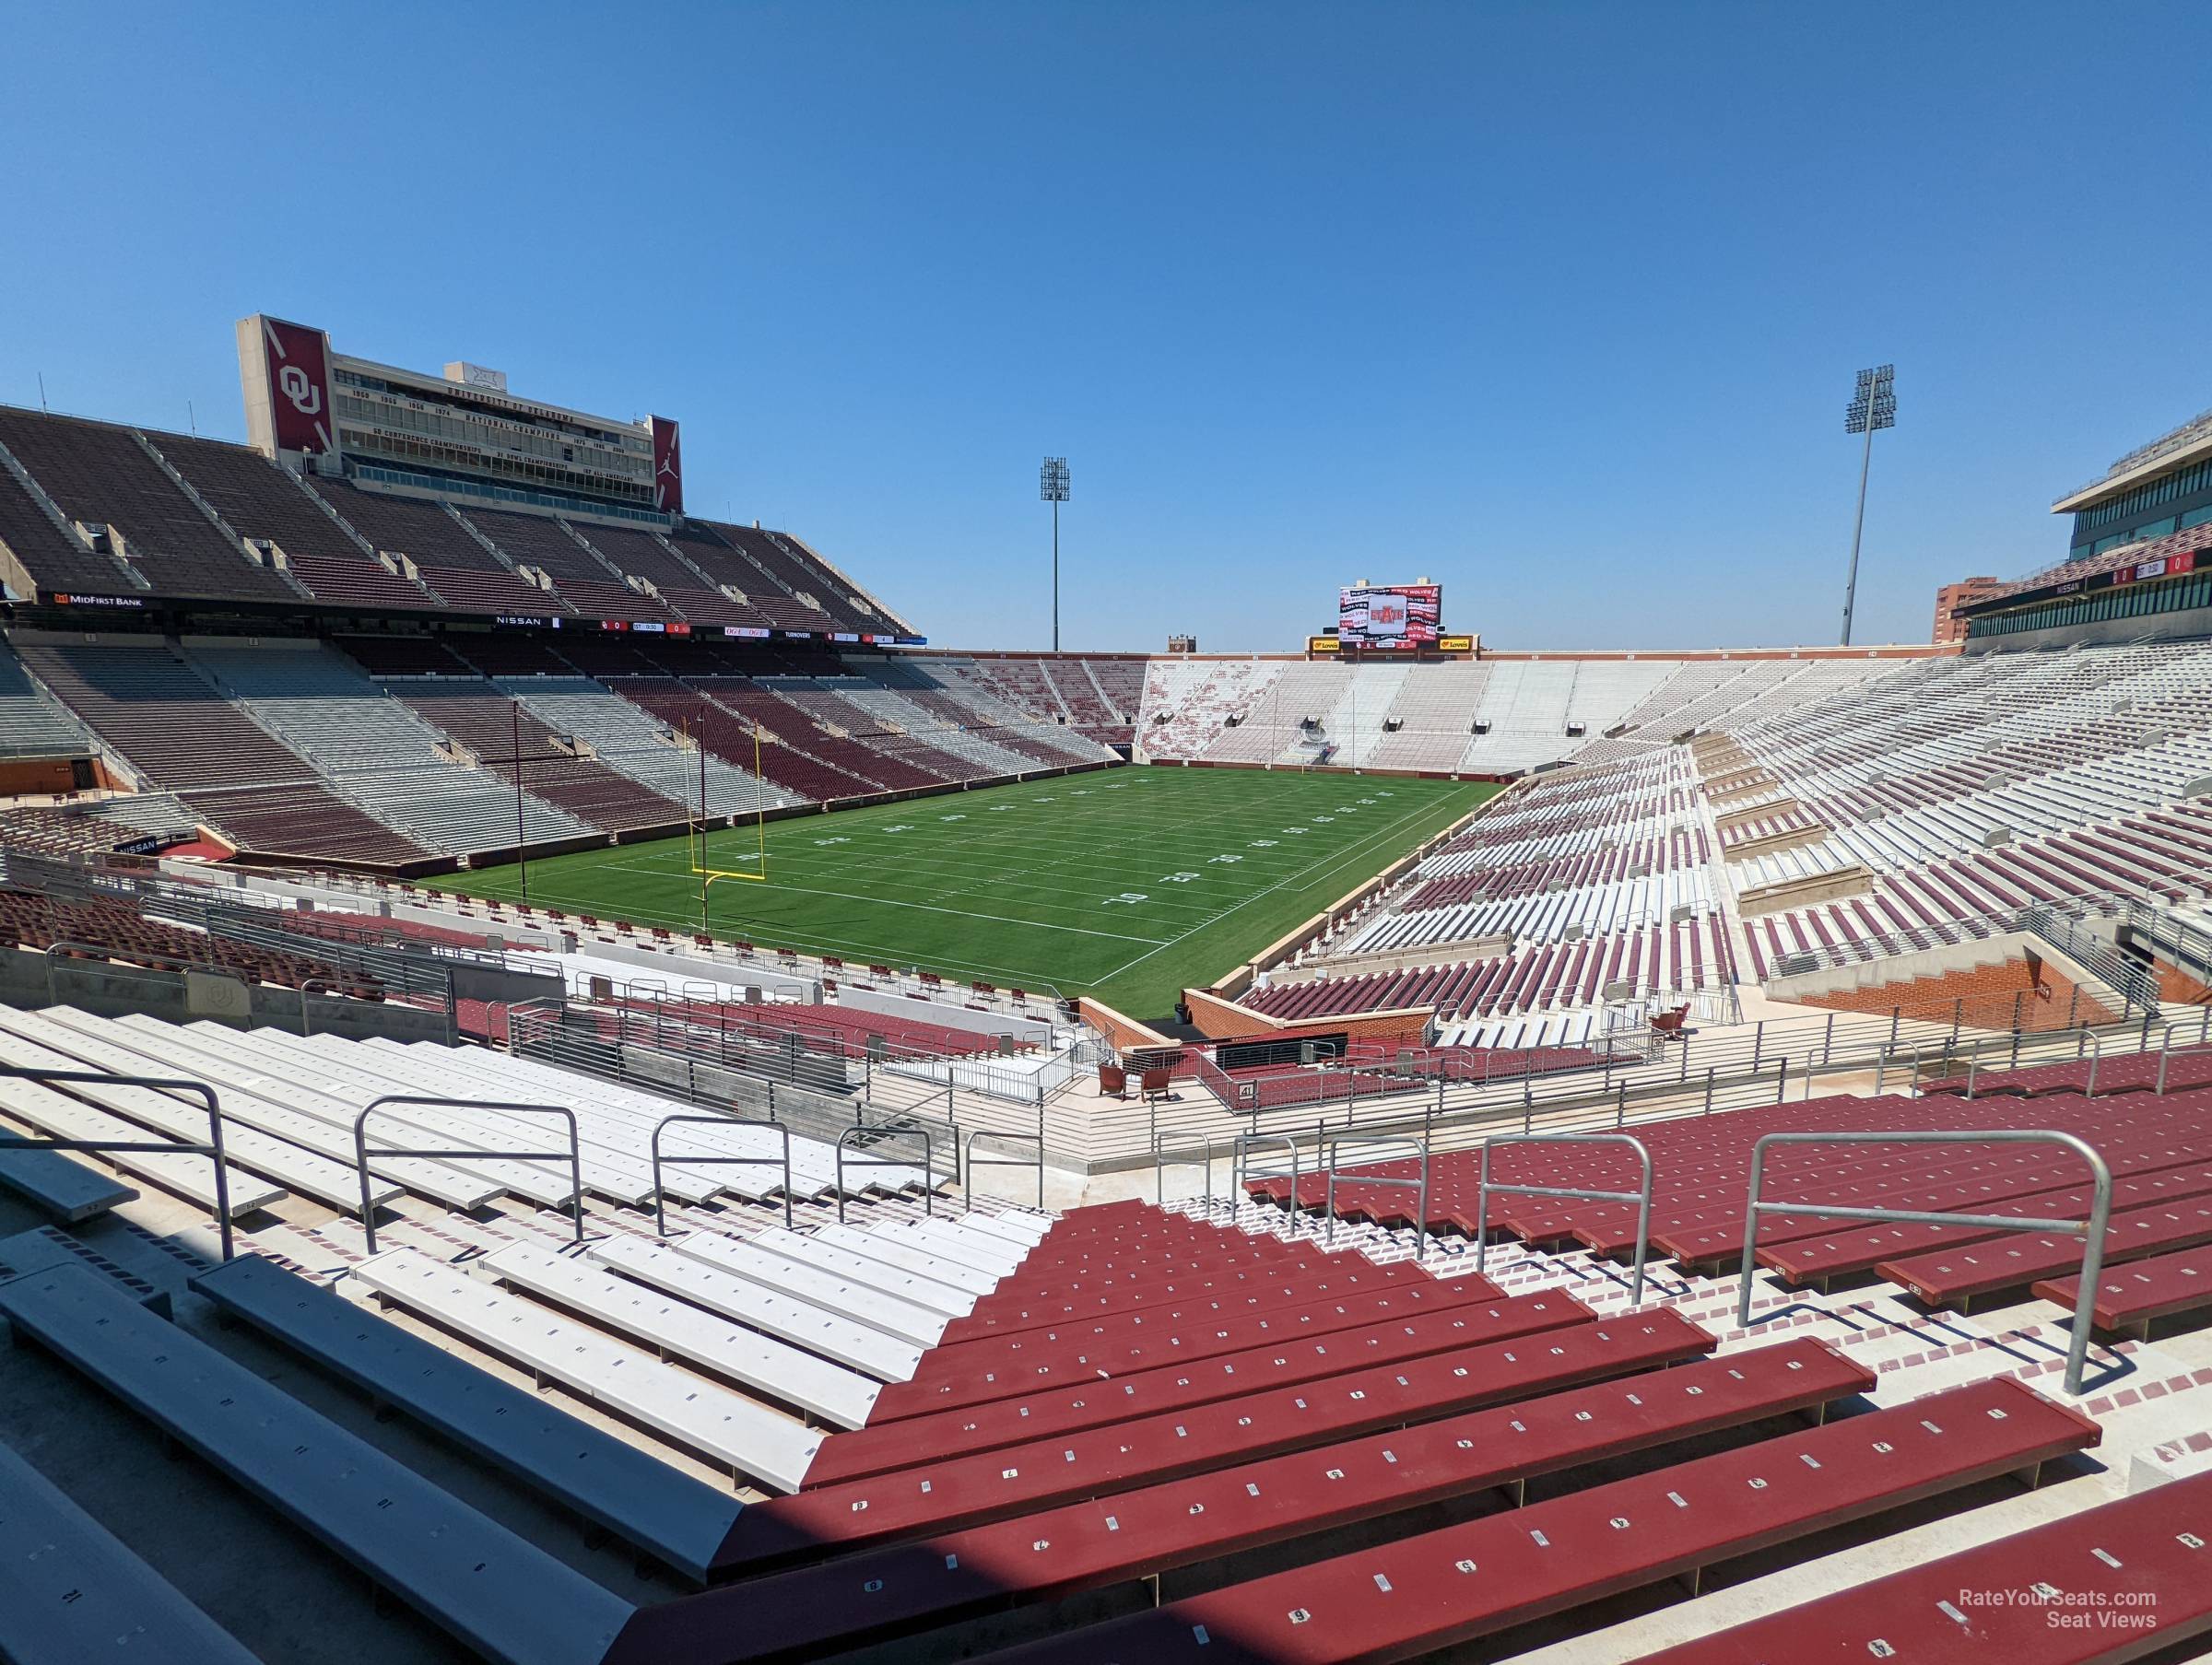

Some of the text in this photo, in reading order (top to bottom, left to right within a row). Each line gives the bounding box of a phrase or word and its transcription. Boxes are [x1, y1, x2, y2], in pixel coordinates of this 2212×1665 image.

[279, 365, 321, 414] OU
[447, 387, 508, 407] UNIVERSITY
[528, 405, 573, 423] OKLAHOMA
[465, 414, 510, 429] NATIONAL
[513, 425, 560, 440] CHAMPIONS
[384, 430, 429, 443] CONFERENCE
[430, 439, 482, 454] CHAMPIONSHIPS
[524, 456, 568, 470] CHAMPIONSHIPS
[2174, 557, 2181, 569] 0
[496, 616, 541, 625] NISSAN
[1411, 616, 1436, 625] WOLVES
[1161, 872, 1201, 883] 20
[1107, 893, 1148, 904] 10
[1653, 1038, 1663, 1048] 36
[1241, 1087, 1251, 1096] 41
[377, 1498, 394, 1509] 10
[2182, 1535, 2199, 1546] 2
